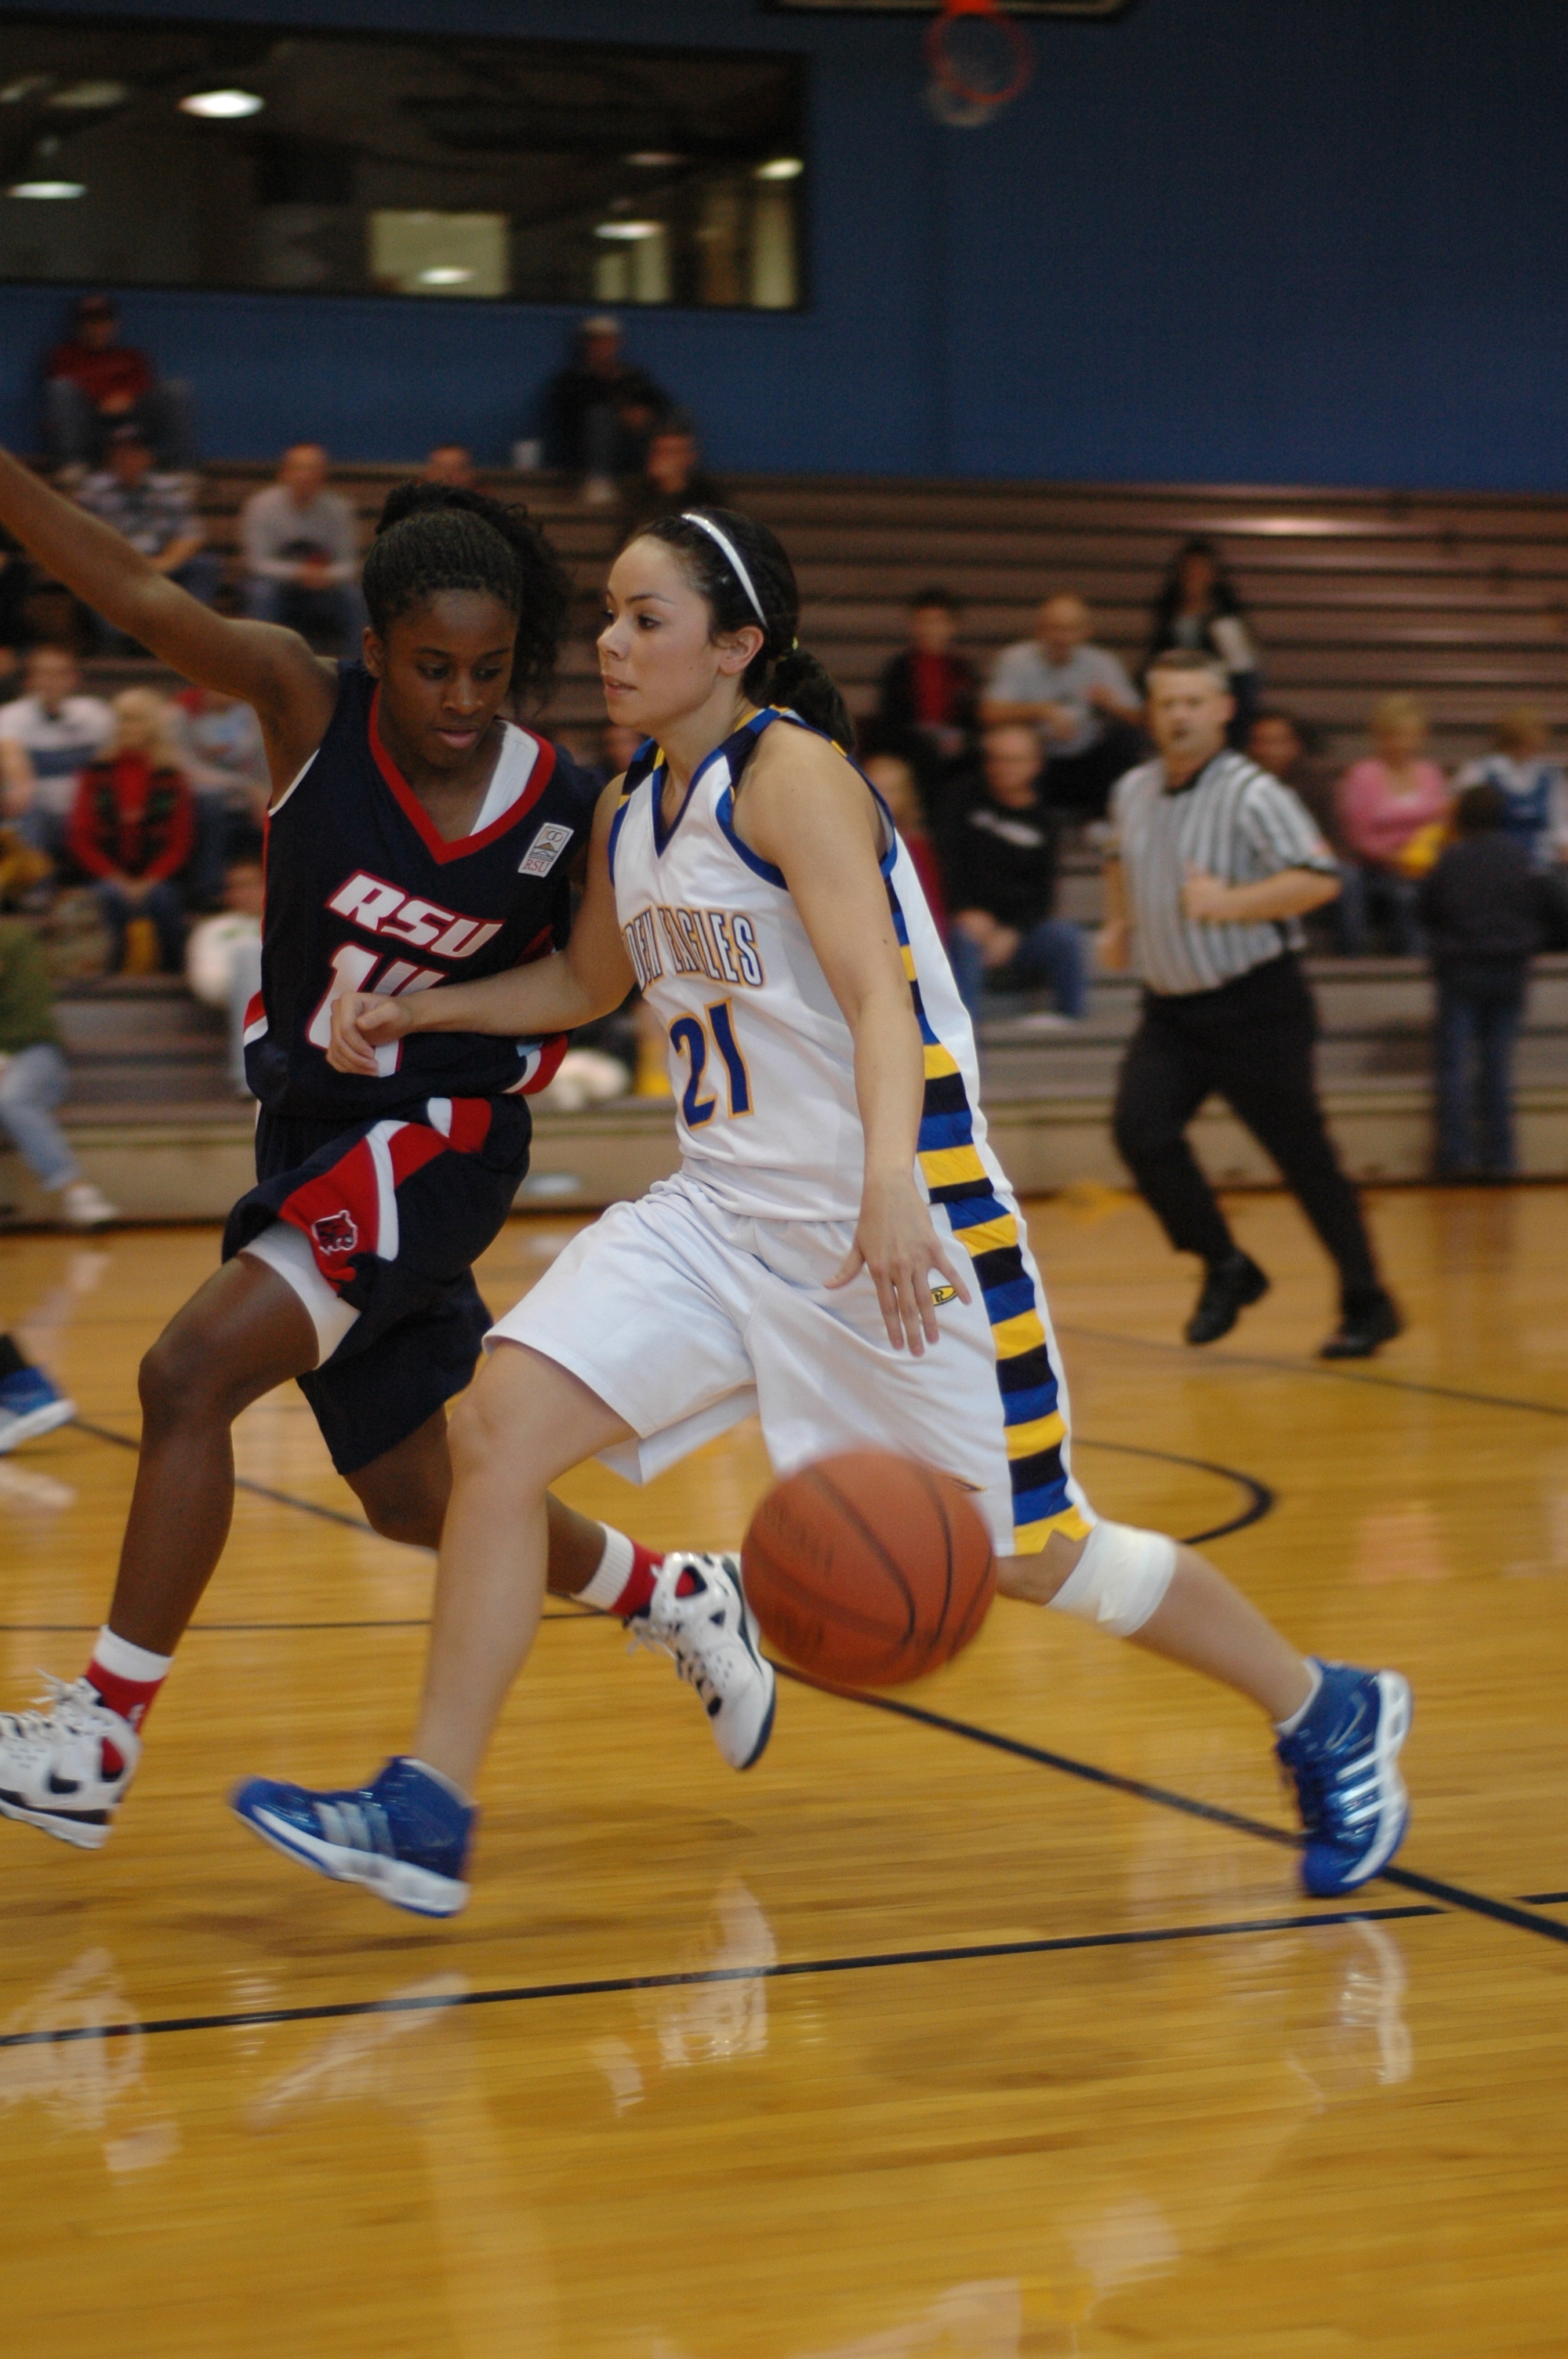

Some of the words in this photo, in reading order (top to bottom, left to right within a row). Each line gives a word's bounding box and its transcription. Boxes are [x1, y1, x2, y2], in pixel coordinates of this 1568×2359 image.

[523, 858, 550, 873] RSU
[325, 869, 506, 960] RSU
[622, 906, 665, 996] DEN
[655, 904, 767, 990] EAGLES
[668, 997, 754, 1132] 21
